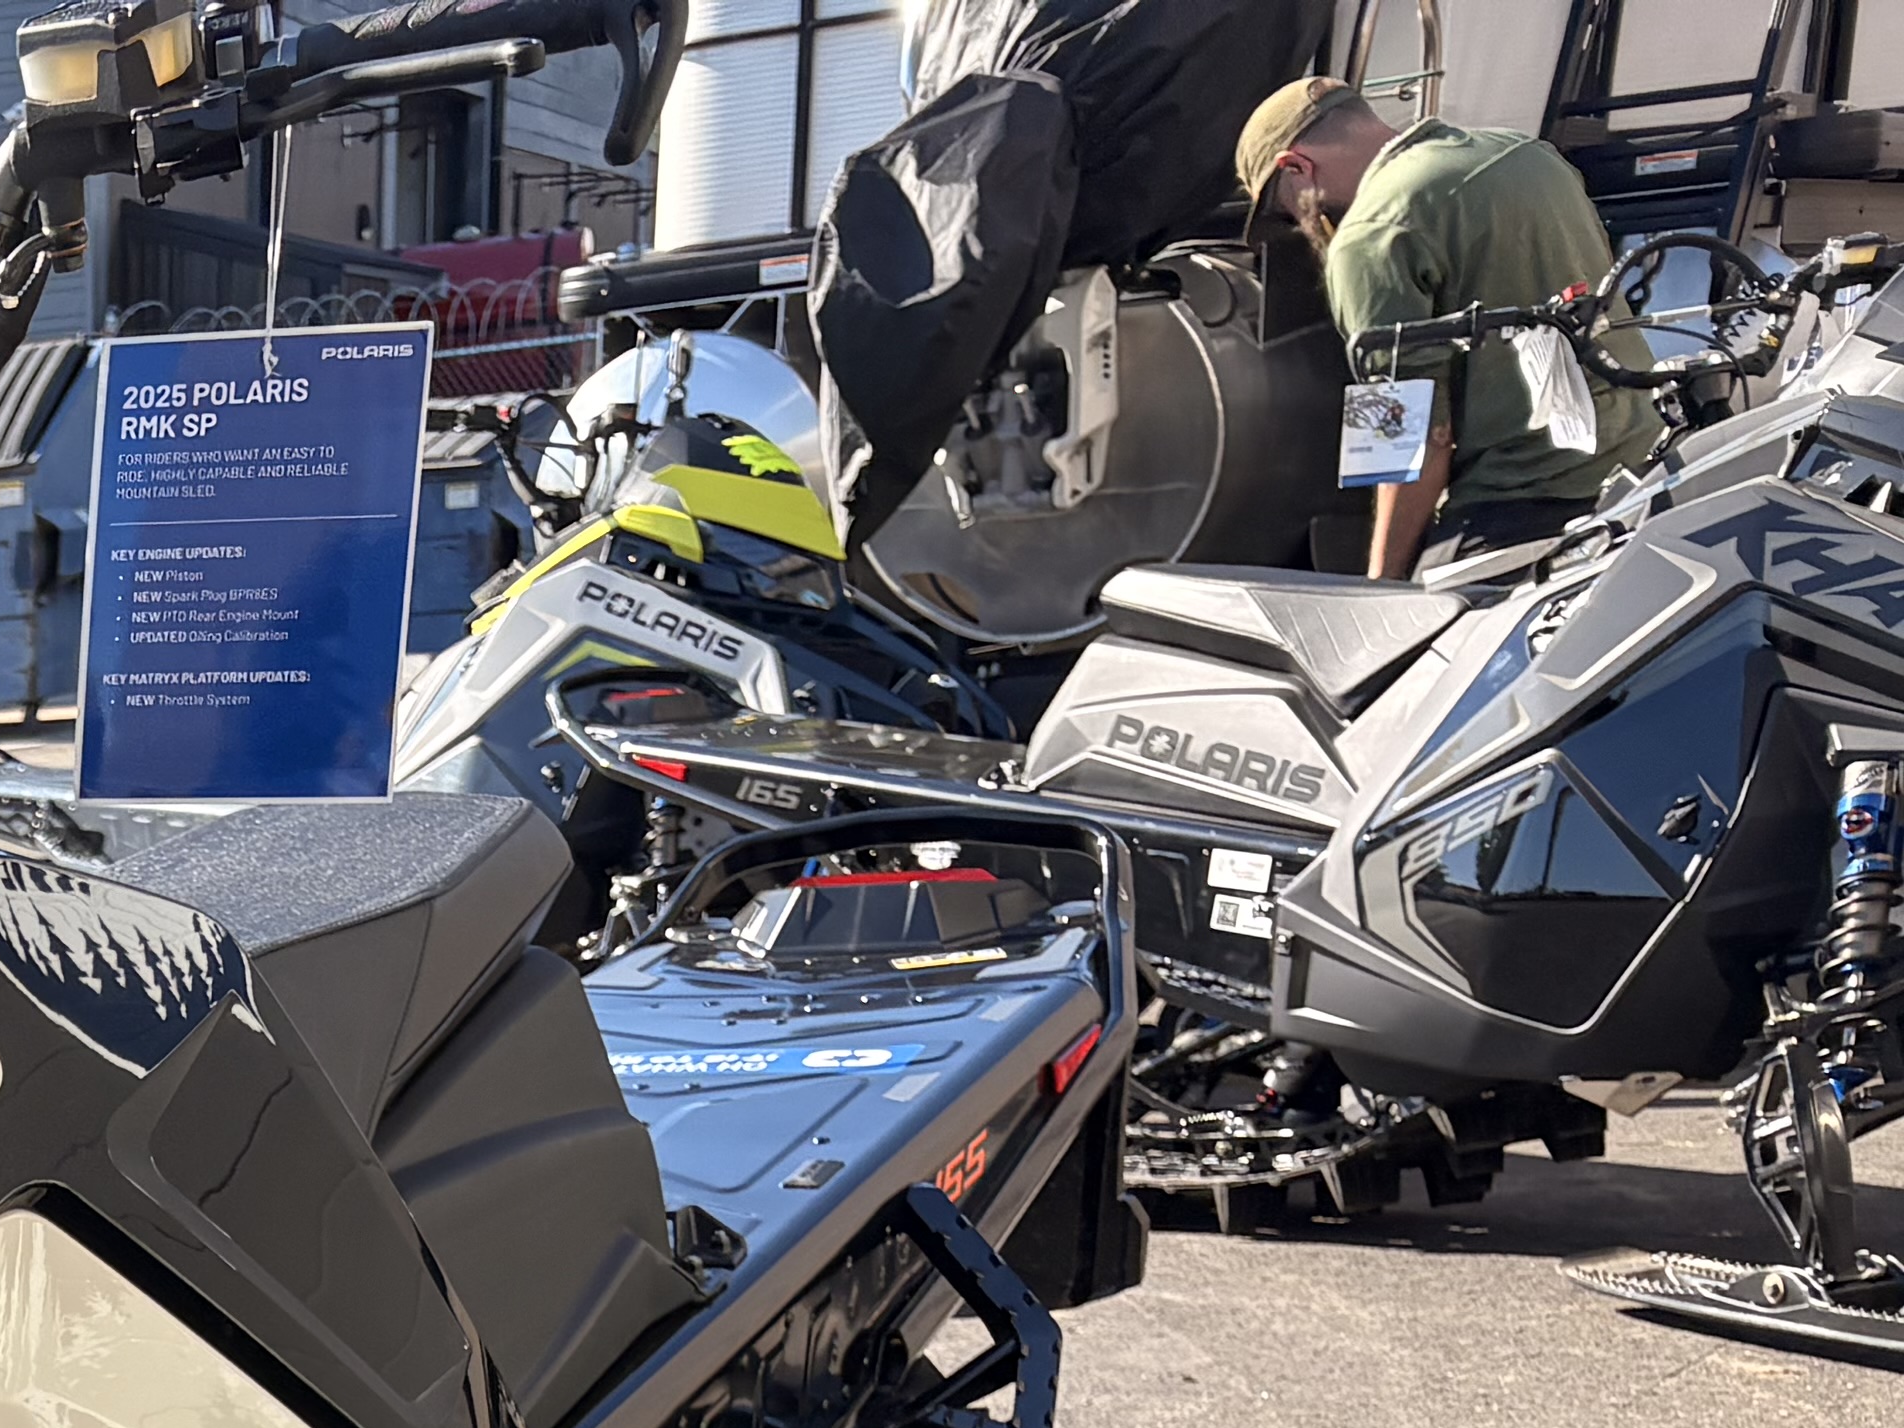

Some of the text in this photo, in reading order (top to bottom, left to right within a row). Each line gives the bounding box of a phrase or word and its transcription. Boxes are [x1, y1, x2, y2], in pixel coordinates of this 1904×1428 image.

[321, 343, 414, 361] POLARIS
[123, 378, 309, 410] 2025 POLARIS
[120, 413, 217, 440] RMK SP
[118, 446, 334, 466] FOR RIDERS WHO WANT AN EASY TO
[151, 468, 196, 482] HIGHLY
[198, 465, 255, 480] CAPABLE
[258, 465, 284, 477] AND
[287, 462, 349, 476] RELIABLE
[116, 486, 179, 500] MOUNTAIN
[111, 546, 247, 561] KEY ENGINE UPDATES:
[134, 569, 203, 582] NEW Piston
[133, 591, 162, 603] NEW
[164, 590, 198, 604] Spark
[200, 589, 227, 603] Plug
[131, 611, 161, 623] NEW
[189, 609, 216, 621] Rear
[219, 608, 259, 623] Engine
[262, 608, 299, 620] Mount
[577, 579, 747, 664] POLARIS
[130, 631, 187, 643] UPDATED
[224, 629, 288, 641] Calibration
[103, 670, 311, 685] KEY MATRYX PLATFORM UPDATES:
[126, 693, 250, 708] NEW Throttle System
[1107, 714, 1325, 803] POLARIS
[735, 776, 803, 810] 165
